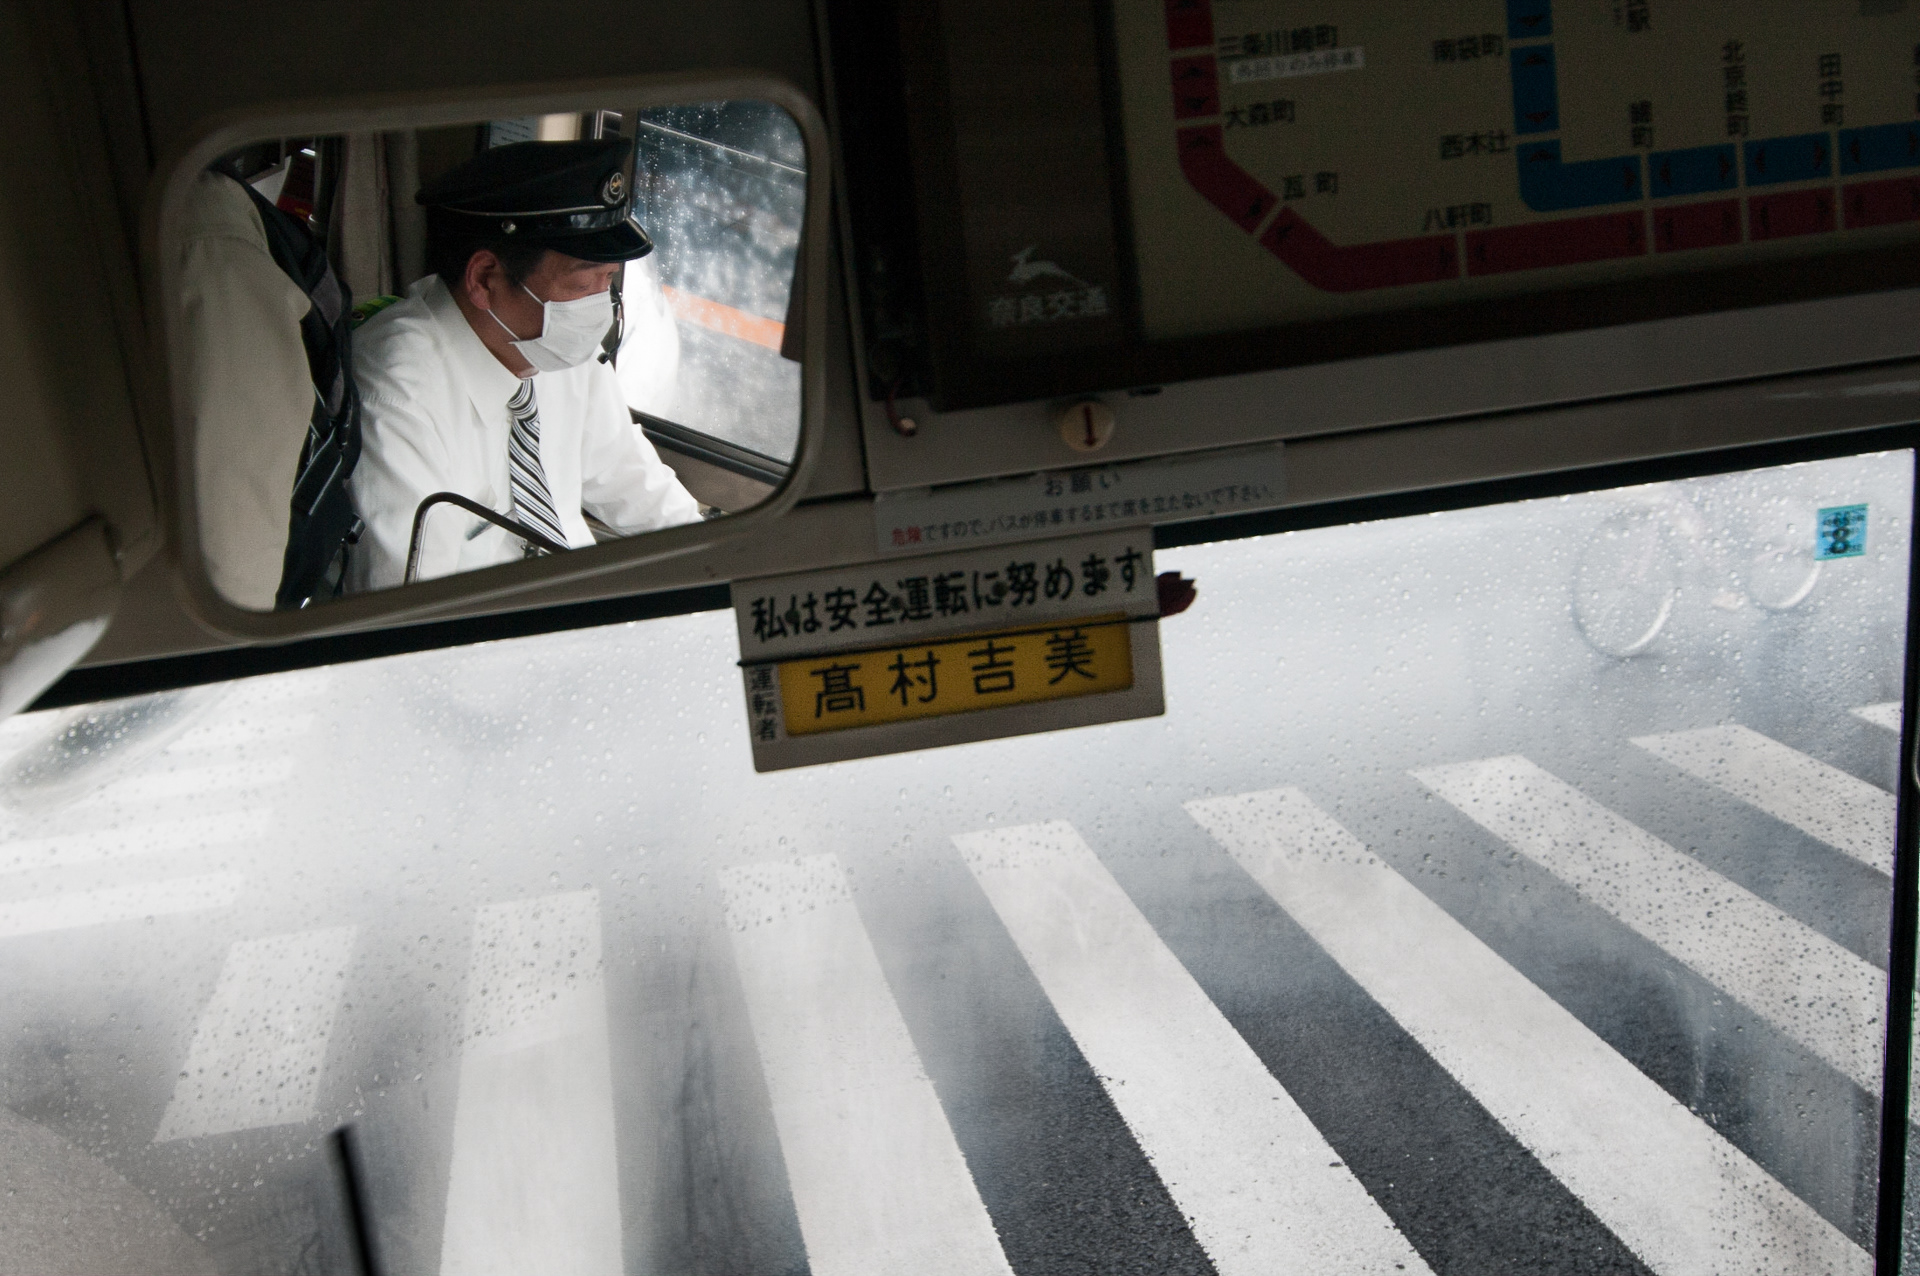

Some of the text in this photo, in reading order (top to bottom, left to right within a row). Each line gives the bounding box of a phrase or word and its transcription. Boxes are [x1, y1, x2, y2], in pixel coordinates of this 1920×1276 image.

[1225, 99, 1295, 129] 大森町
[1818, 52, 1844, 127] 田中町
[1440, 130, 1510, 160] 西木辻
[751, 546, 1144, 643] 私は安全運転に努めます
